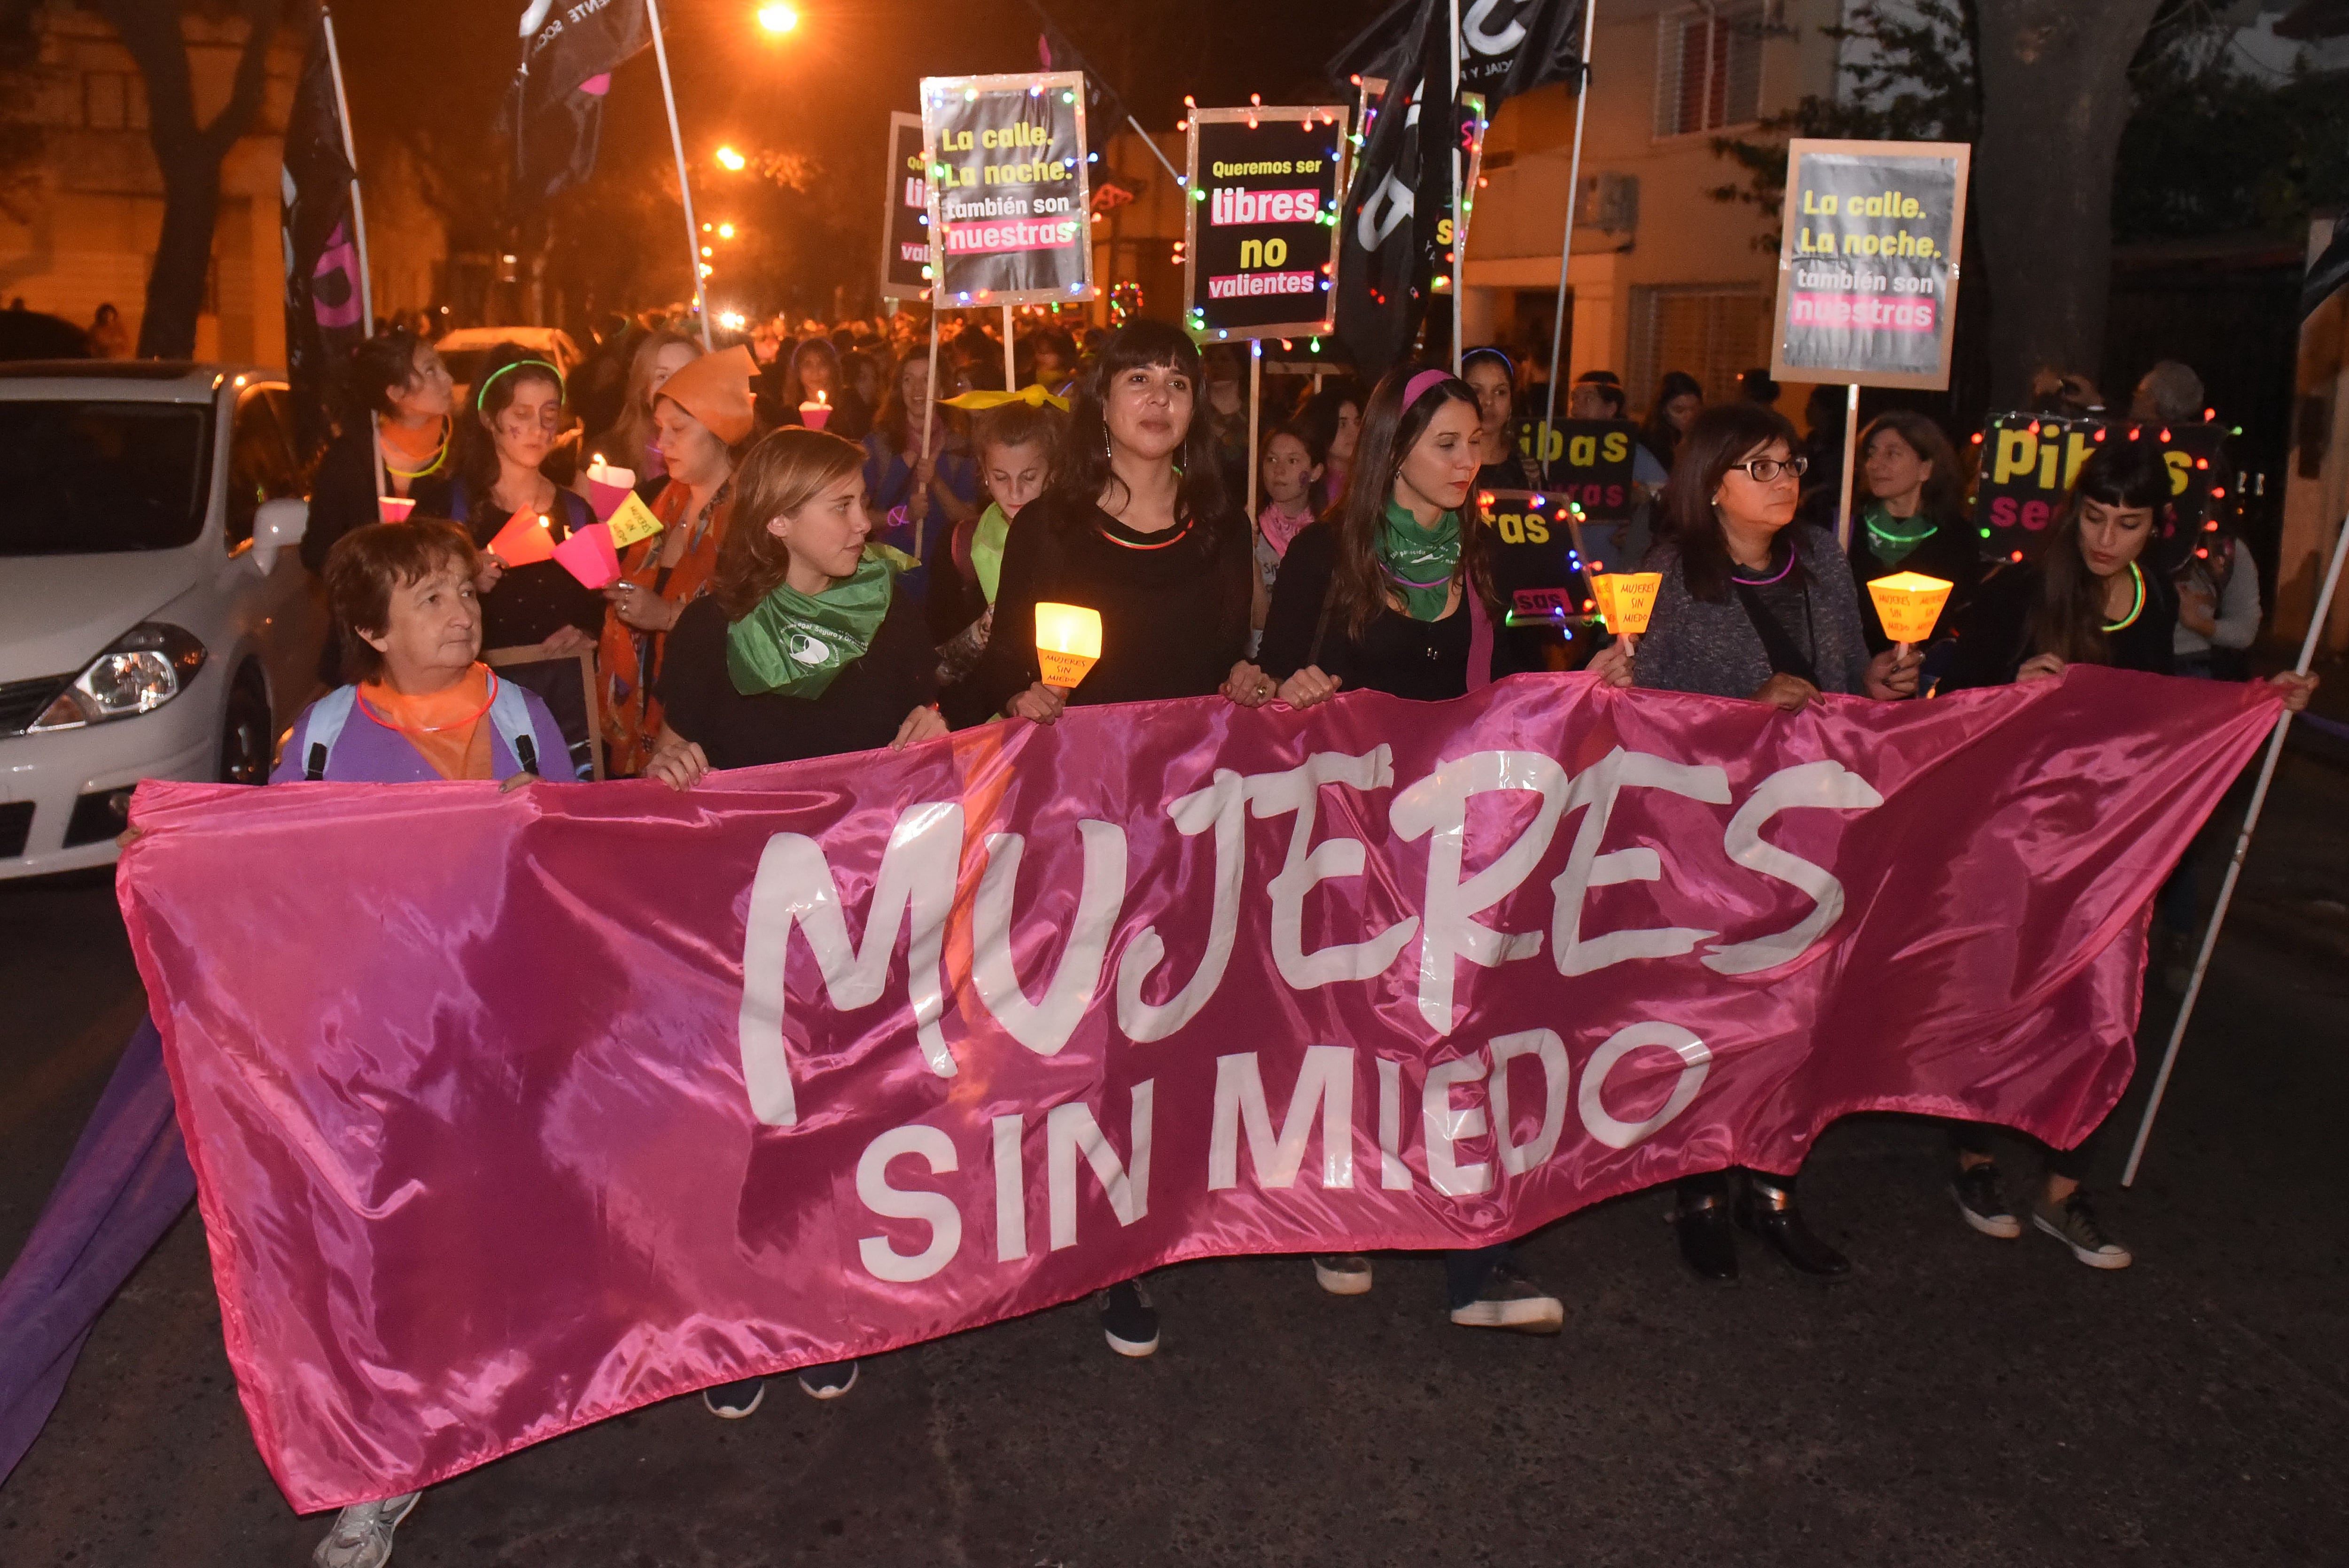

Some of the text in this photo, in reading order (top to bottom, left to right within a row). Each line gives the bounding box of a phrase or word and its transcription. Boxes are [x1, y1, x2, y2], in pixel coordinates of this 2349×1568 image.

[942, 122, 1054, 151] La calle.
[944, 157, 1073, 187] La noche.
[1213, 160, 1322, 178] Queremos ser
[947, 196, 1069, 219] también son
[1804, 190, 1926, 219] La calle.
[949, 222, 1073, 249] nuestras
[1801, 227, 1941, 258] La noche.
[1240, 238, 1287, 269] no
[1209, 273, 1314, 297] valientes
[1797, 268, 1934, 294] también son
[1795, 298, 1932, 326] nuestras
[1519, 420, 1628, 467] ibas
[1621, 582, 1655, 594] MUJERES
[1631, 598, 1644, 609] SIN
[1623, 613, 1648, 623] MIEDO
[1045, 654, 1086, 667] MUJERES
[739, 743, 1885, 1127] MUJERES
[856, 1021, 1712, 1282] SIN MIEDO
